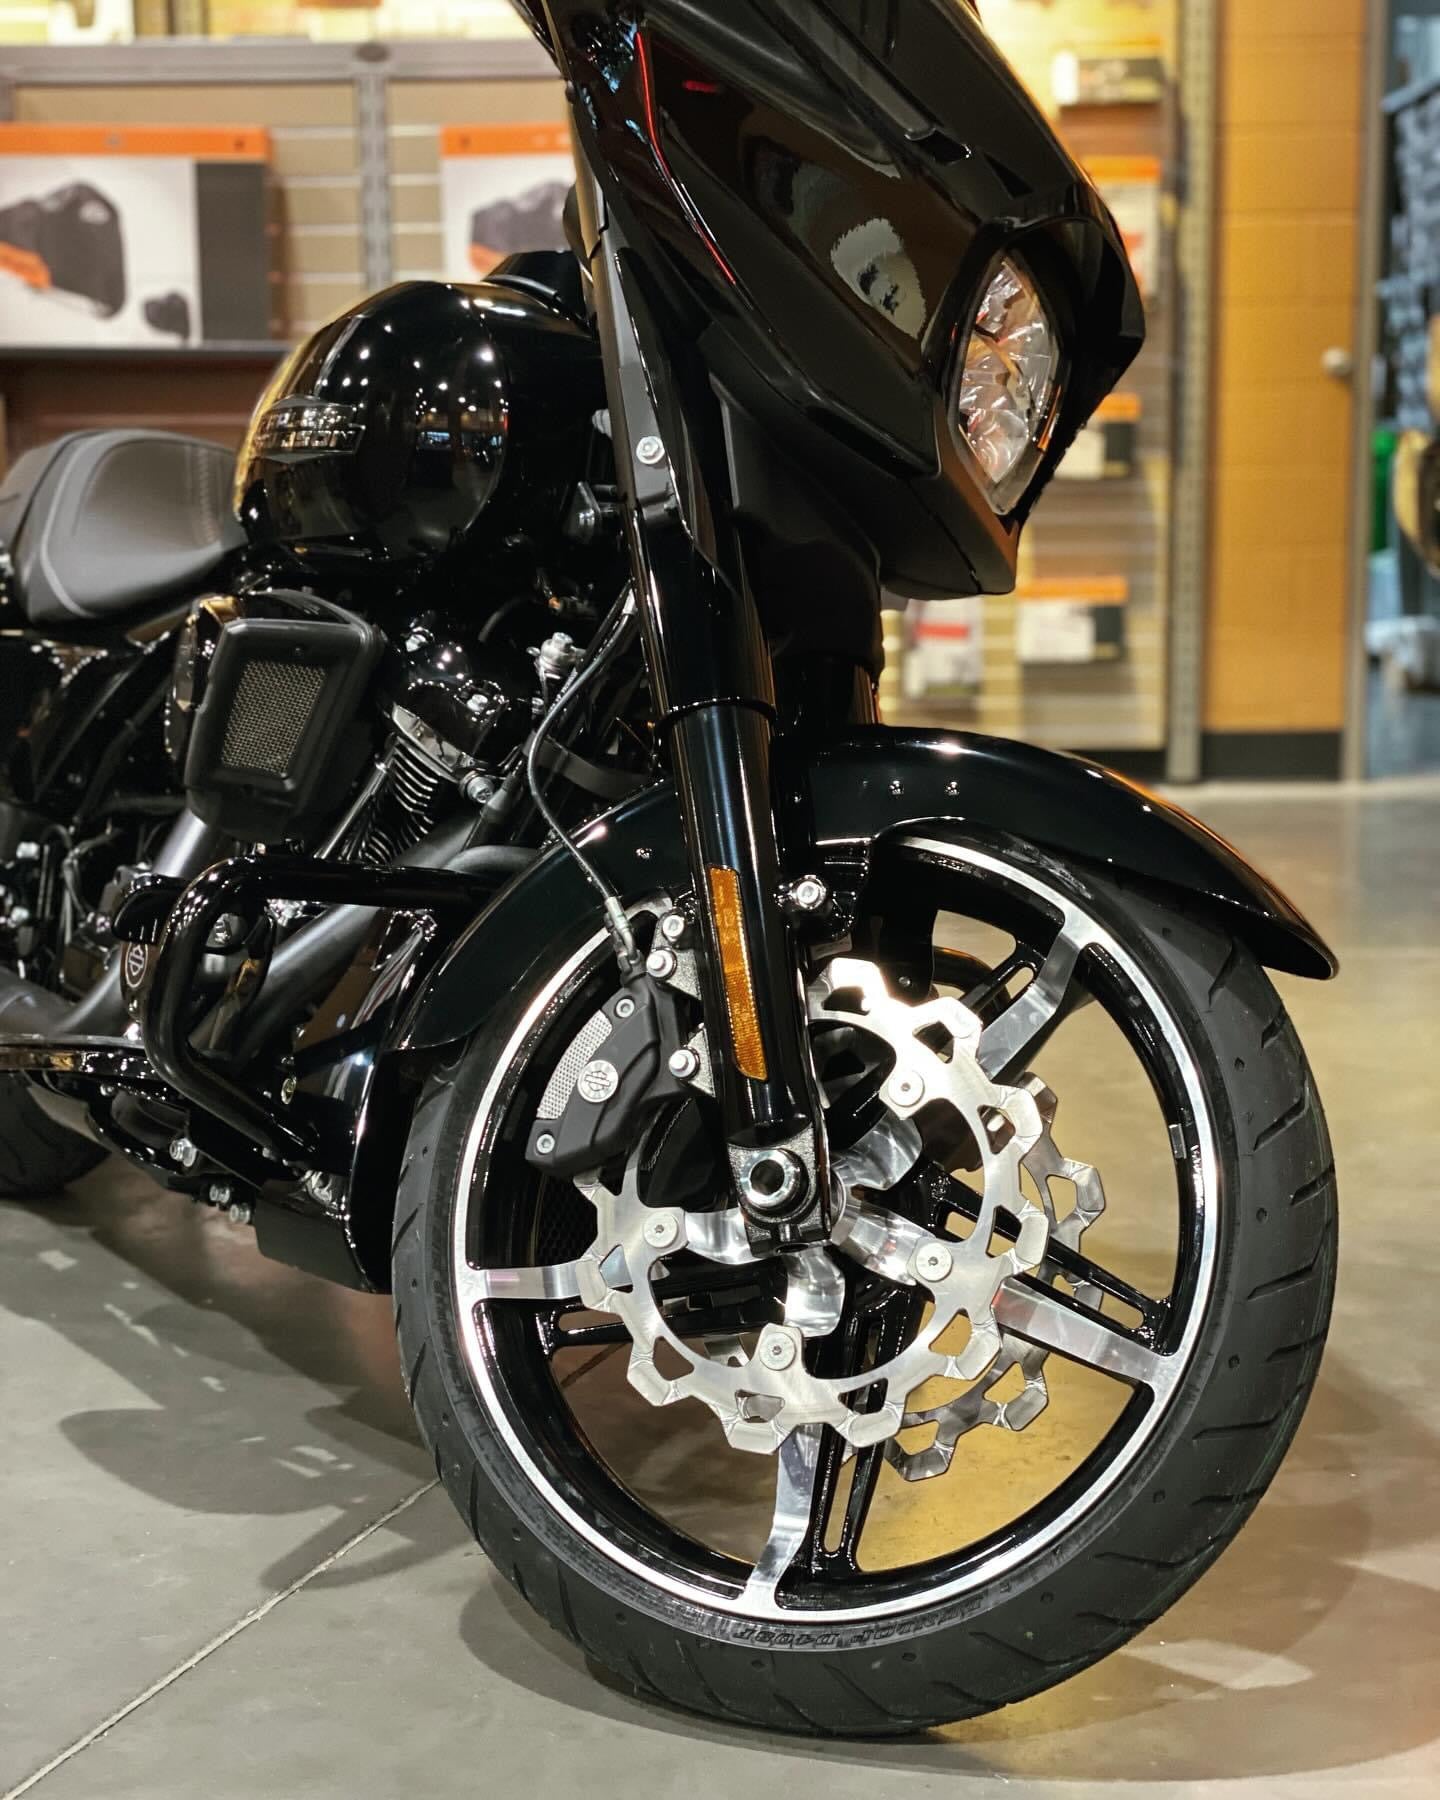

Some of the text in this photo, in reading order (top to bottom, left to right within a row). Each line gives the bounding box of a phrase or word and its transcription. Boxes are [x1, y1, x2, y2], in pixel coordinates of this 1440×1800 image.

[259, 407, 347, 429] RLEY
[255, 430, 356, 450] DSON
[732, 1626, 842, 1648] D408F
